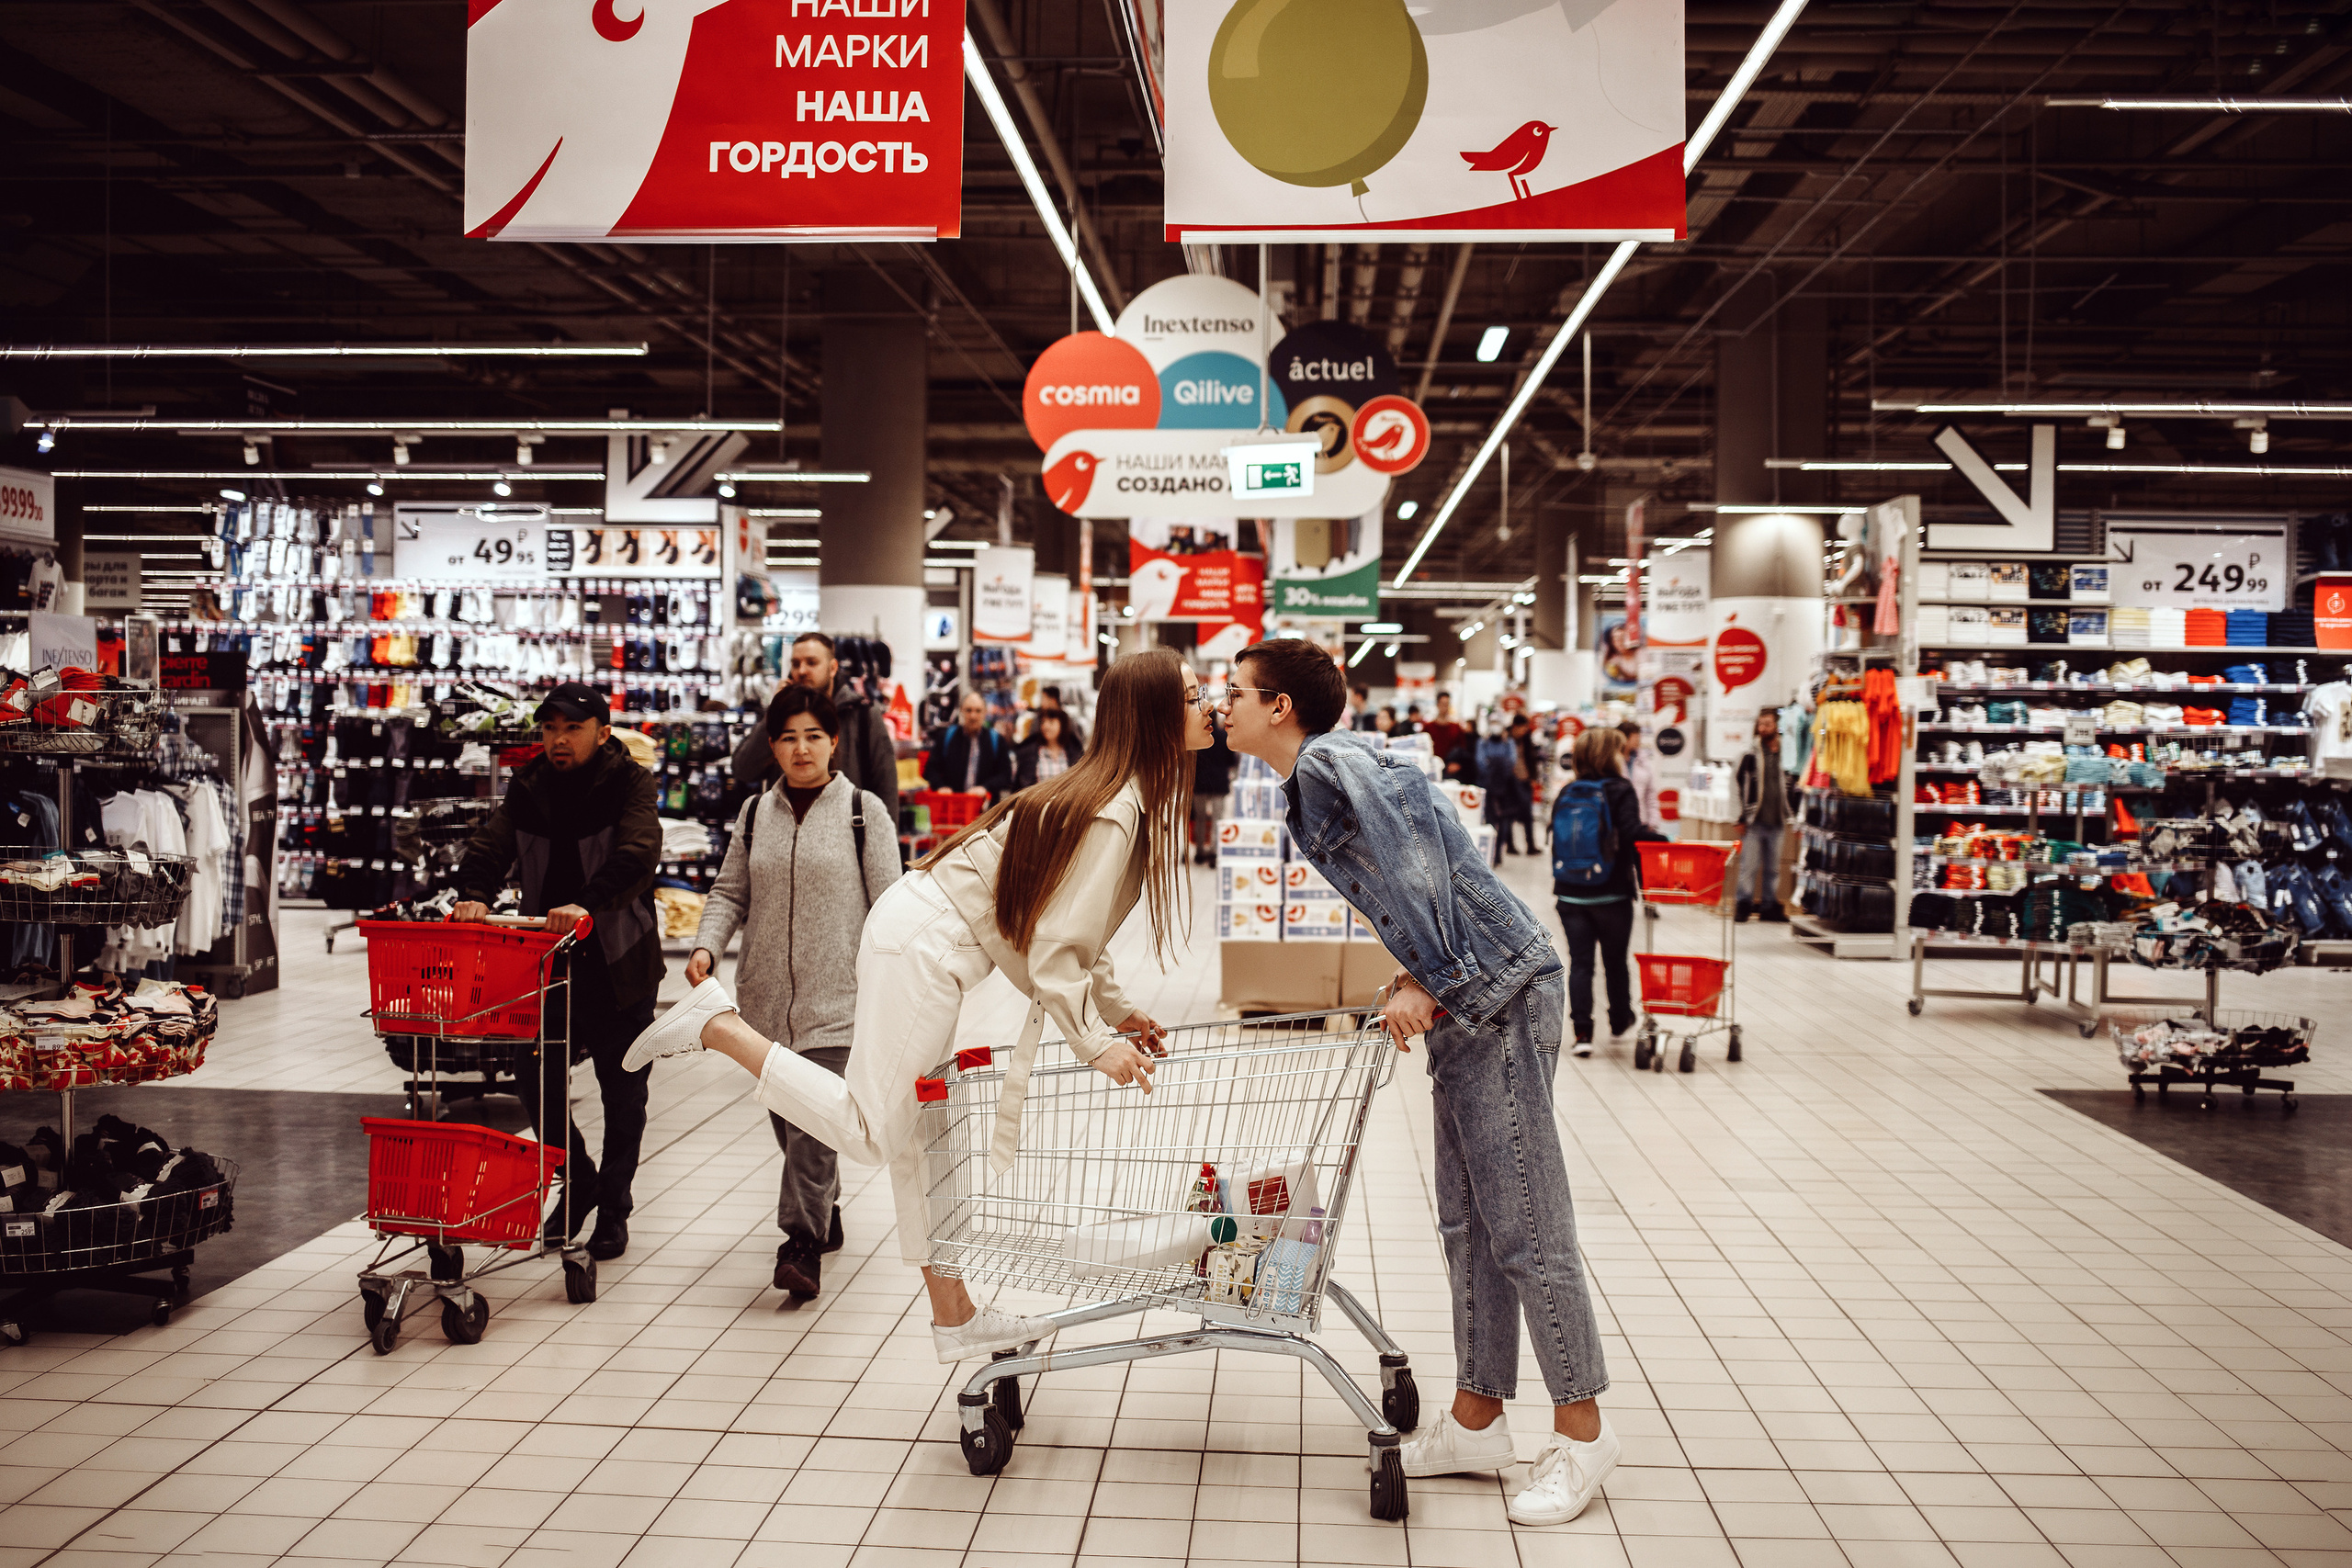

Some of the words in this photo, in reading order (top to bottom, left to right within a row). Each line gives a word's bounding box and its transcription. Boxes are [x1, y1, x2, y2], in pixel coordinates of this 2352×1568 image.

[775, 35, 929, 68] МАРКИ
[797, 90, 931, 122] НАША
[708, 141, 929, 178] ГОРДОСТЬ
[1144, 313, 1255, 335] Inextenso
[1173, 379, 1254, 405] Qilive
[1116, 454, 1182, 469] НАШИ
[1116, 477, 1223, 493] СОЗДАНО
[473, 536, 513, 564] 49
[517, 551, 535, 564] 95
[2143, 580, 2161, 592] от
[2174, 562, 2244, 592] 249
[2247, 579, 2267, 592] 99
[159, 652, 209, 669] pierre
[159, 671, 210, 688] cardin
